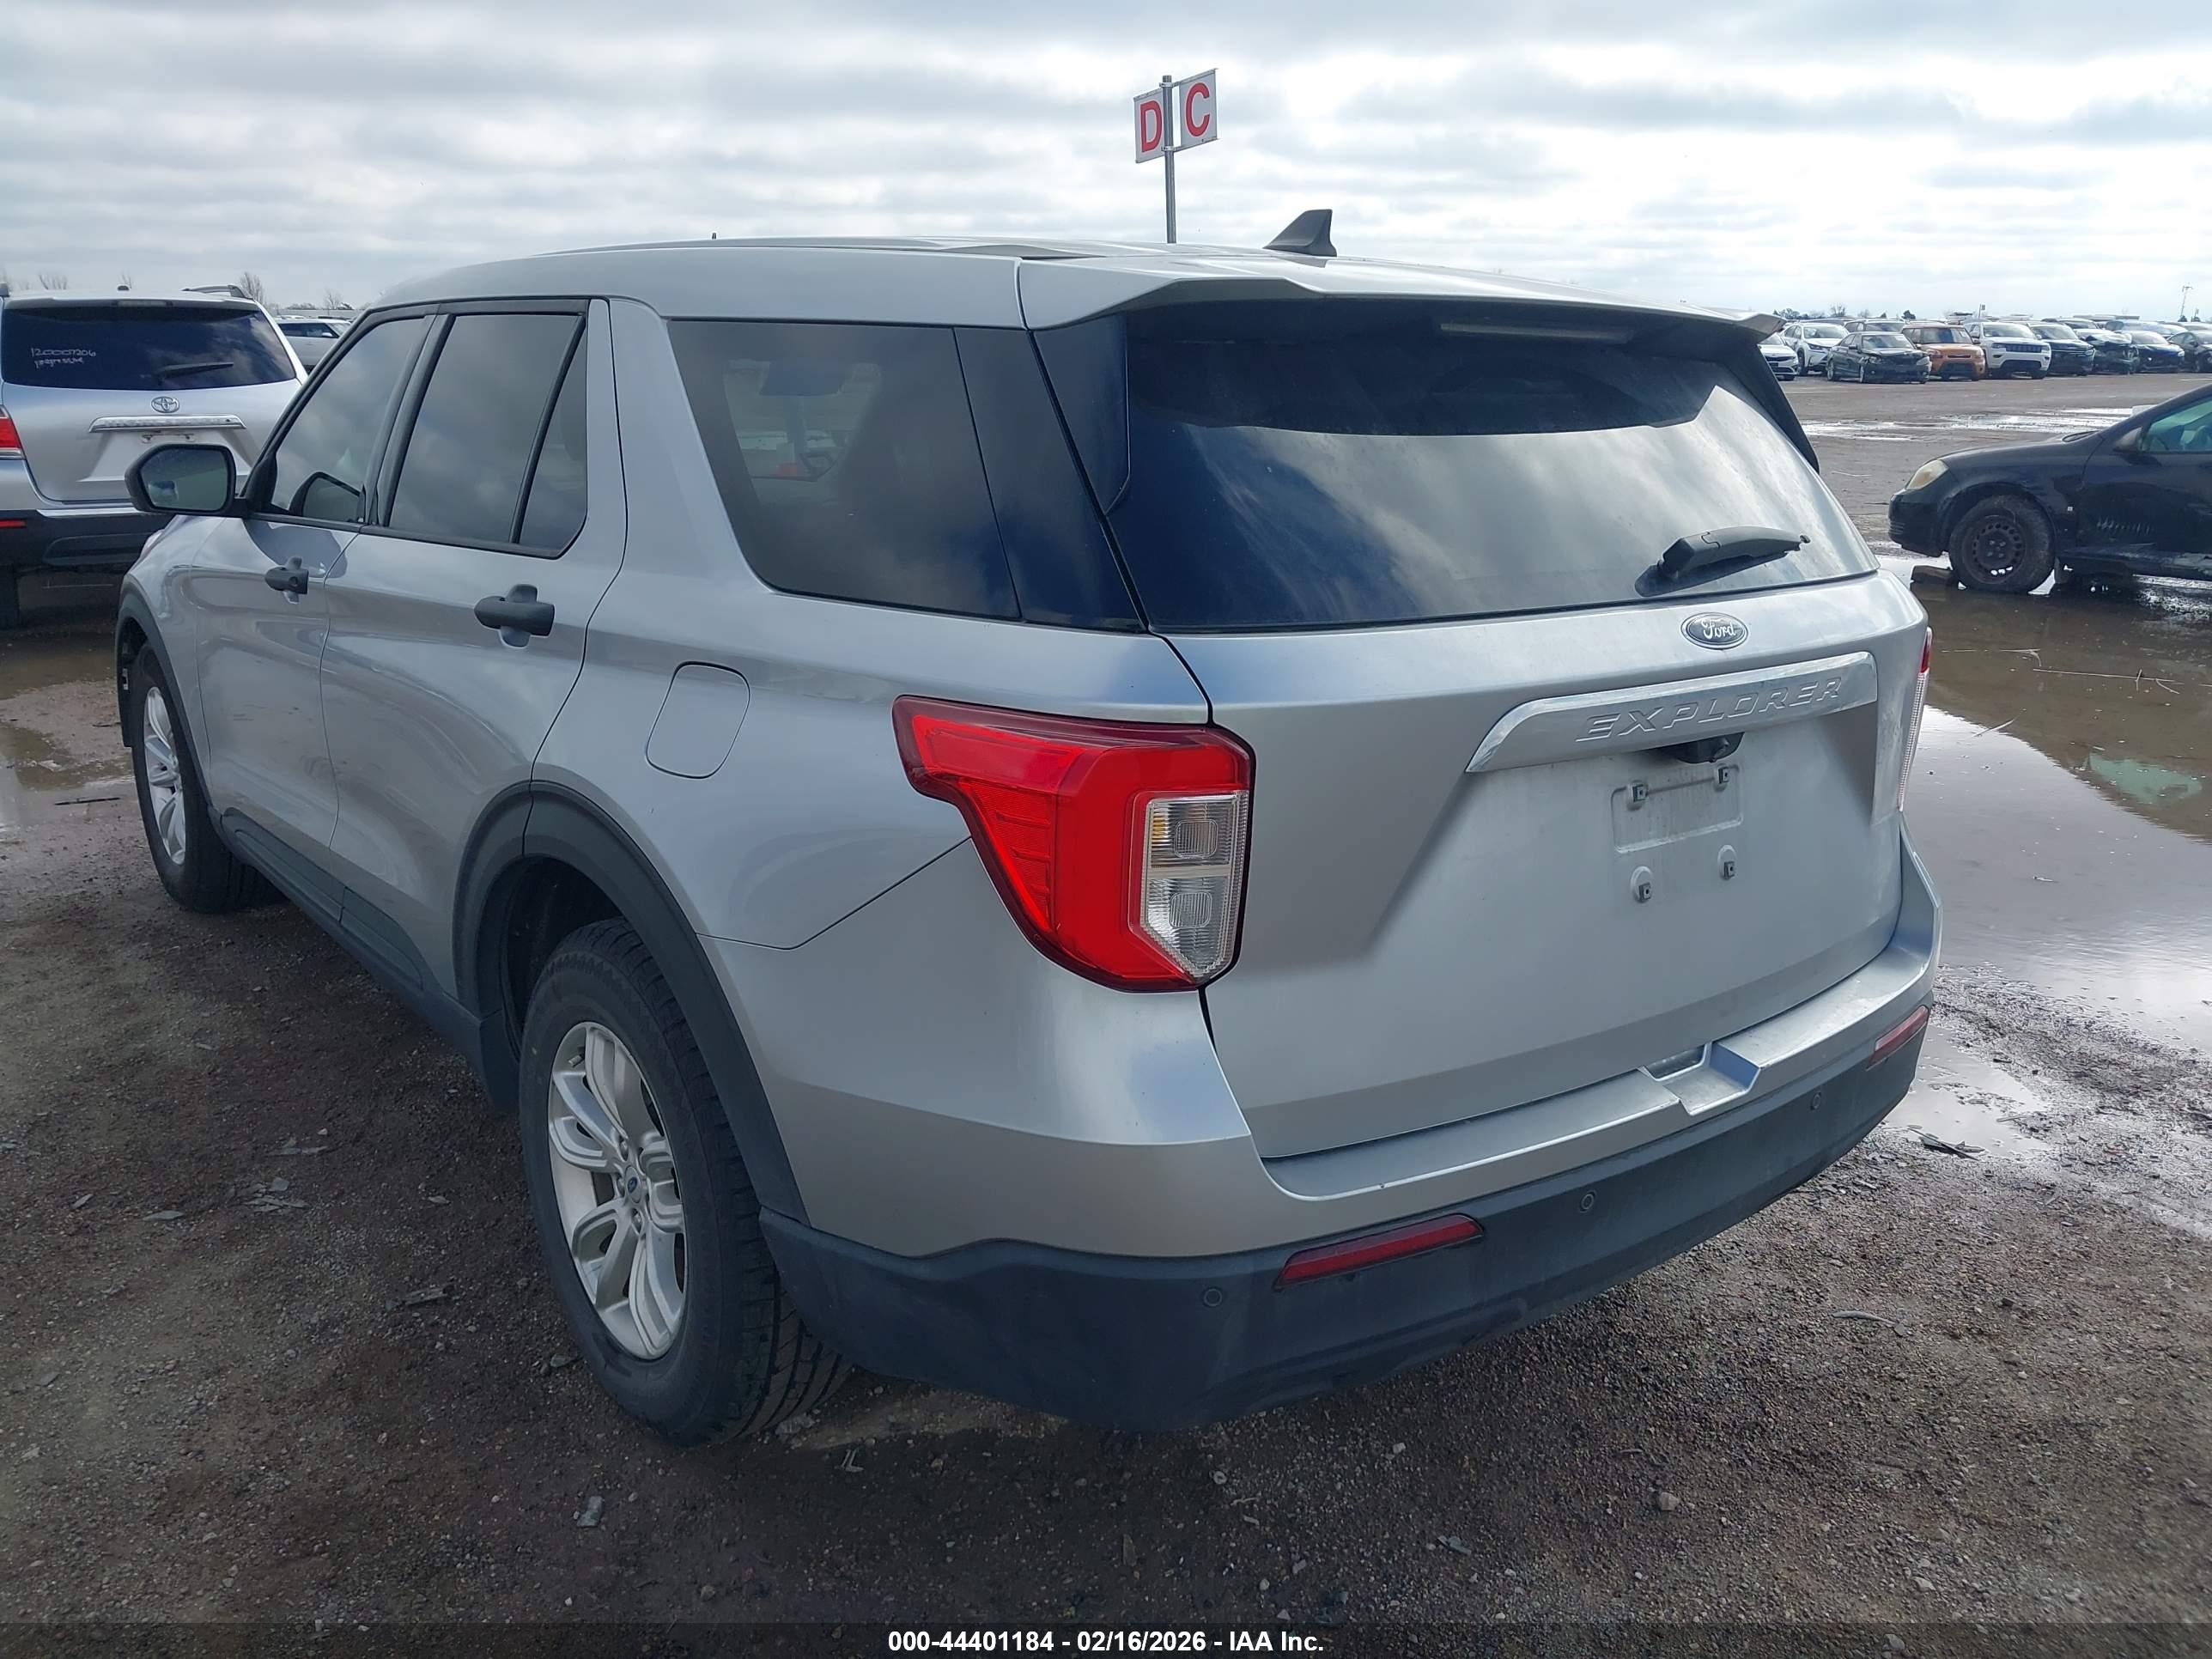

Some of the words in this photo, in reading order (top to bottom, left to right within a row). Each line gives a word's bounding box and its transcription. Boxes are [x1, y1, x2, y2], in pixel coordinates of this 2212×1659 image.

[1139, 100, 1162, 152] D
[1186, 82, 1210, 137] C
[1701, 619, 1736, 640] Ford
[1575, 677, 1842, 742] EXPLORER
